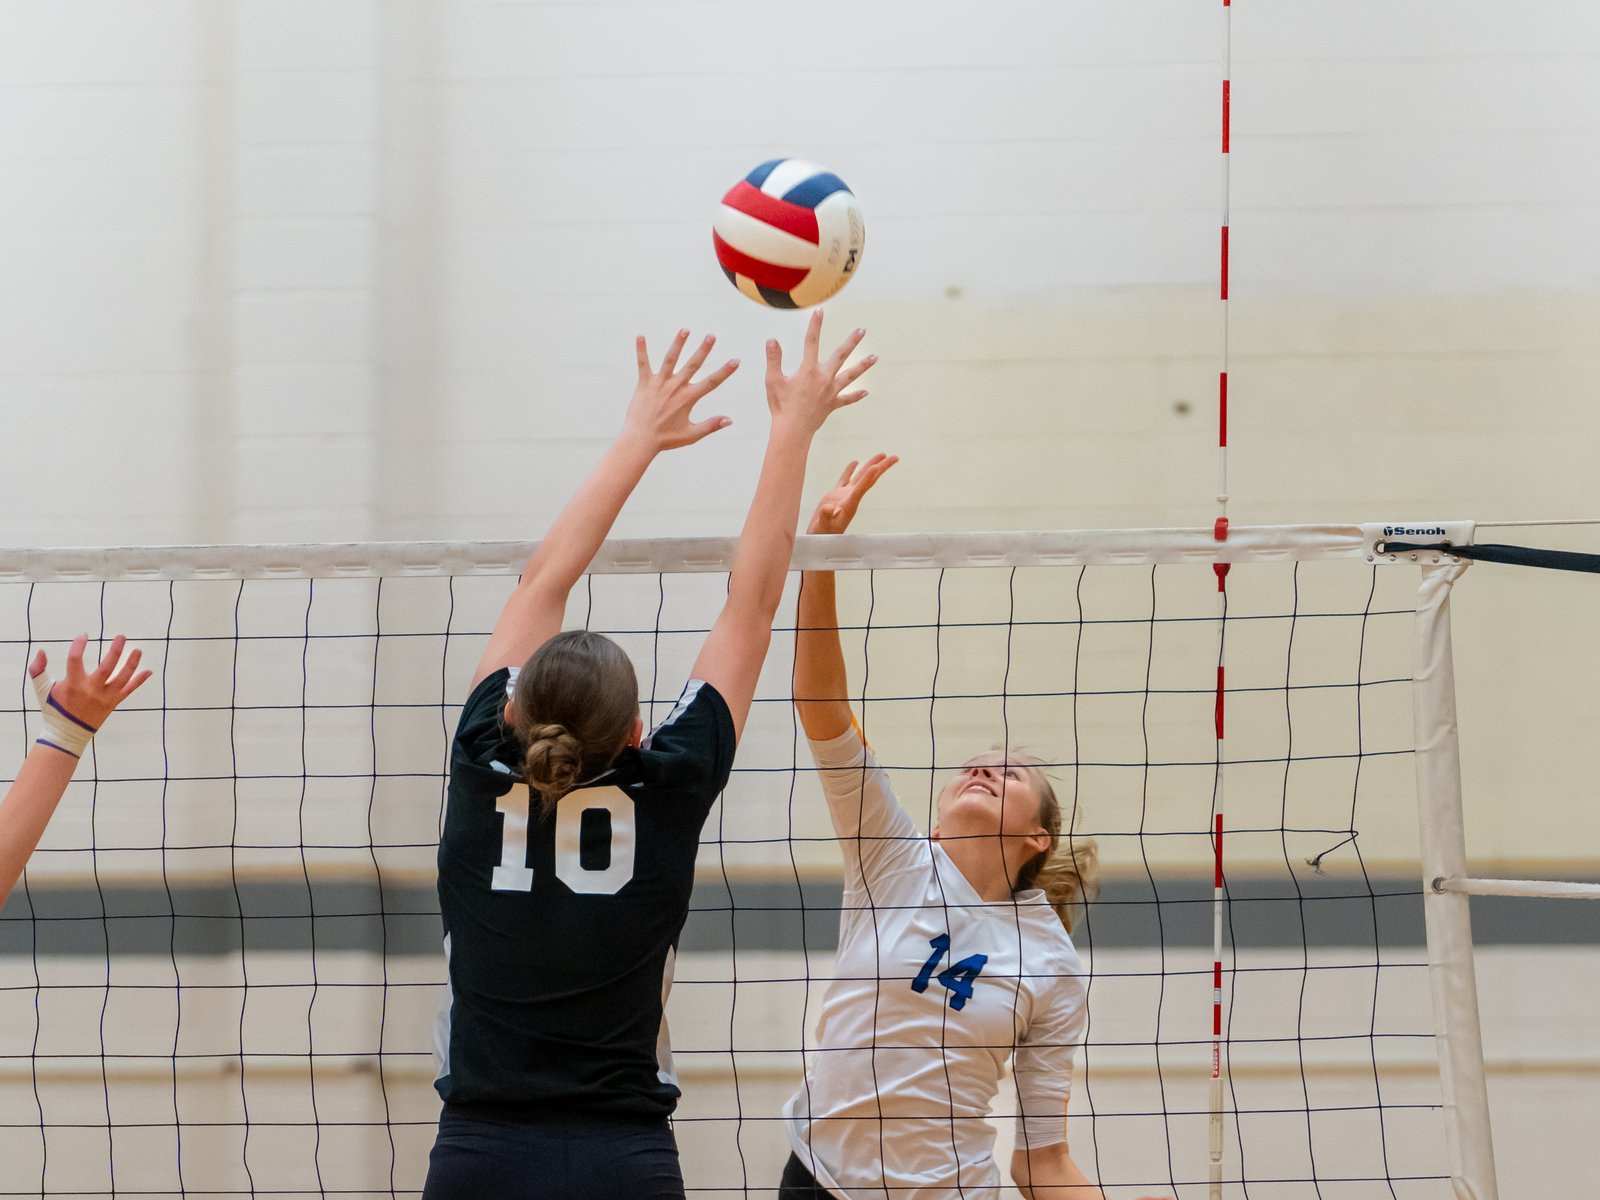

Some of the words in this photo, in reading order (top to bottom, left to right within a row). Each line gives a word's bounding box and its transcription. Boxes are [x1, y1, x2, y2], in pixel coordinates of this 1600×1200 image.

[1394, 526, 1446, 536] Senoh
[490, 782, 637, 895] 10
[910, 932, 989, 1012] 14
